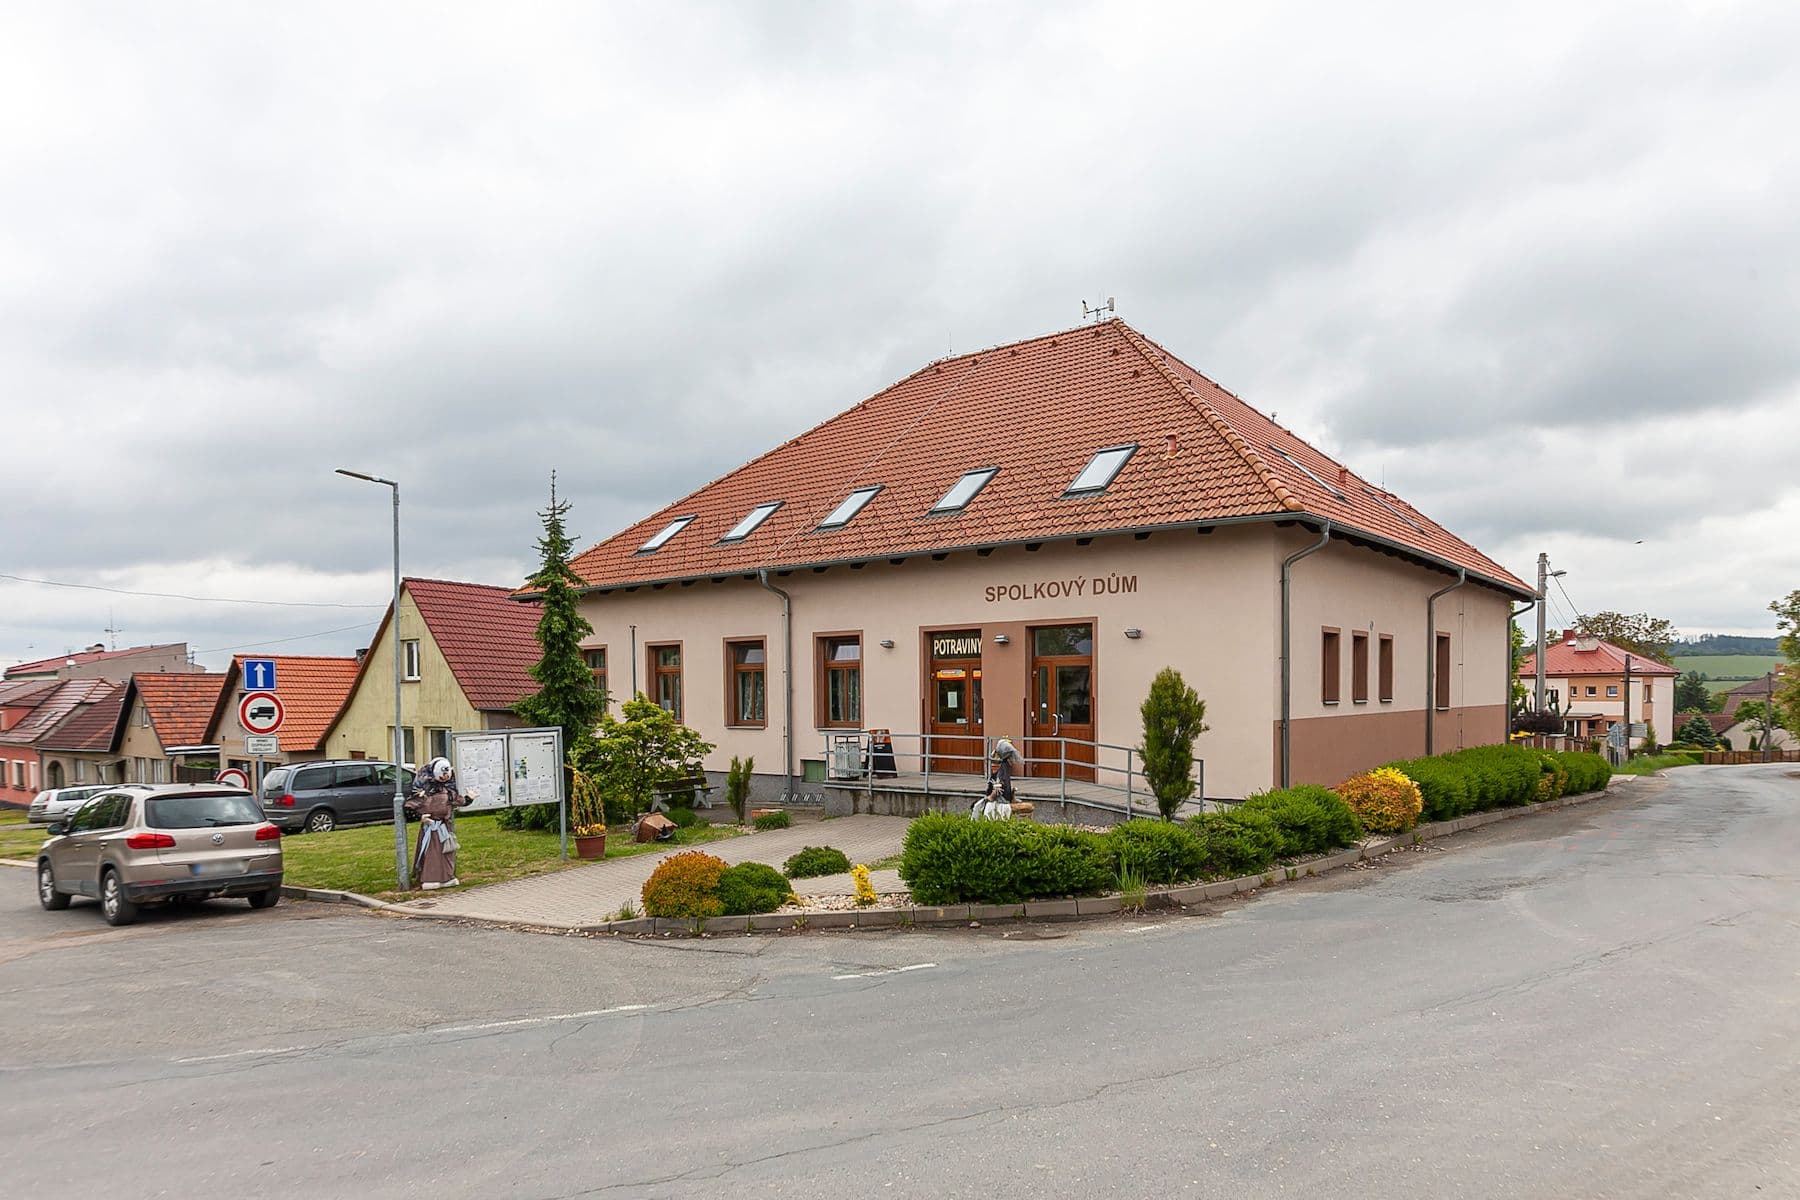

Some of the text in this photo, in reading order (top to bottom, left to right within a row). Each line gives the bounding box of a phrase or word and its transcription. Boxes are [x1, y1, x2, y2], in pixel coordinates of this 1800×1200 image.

[985, 573, 1137, 602] SPOLKOVÝ DŮM
[934, 638, 982, 655] POTRAVINY
